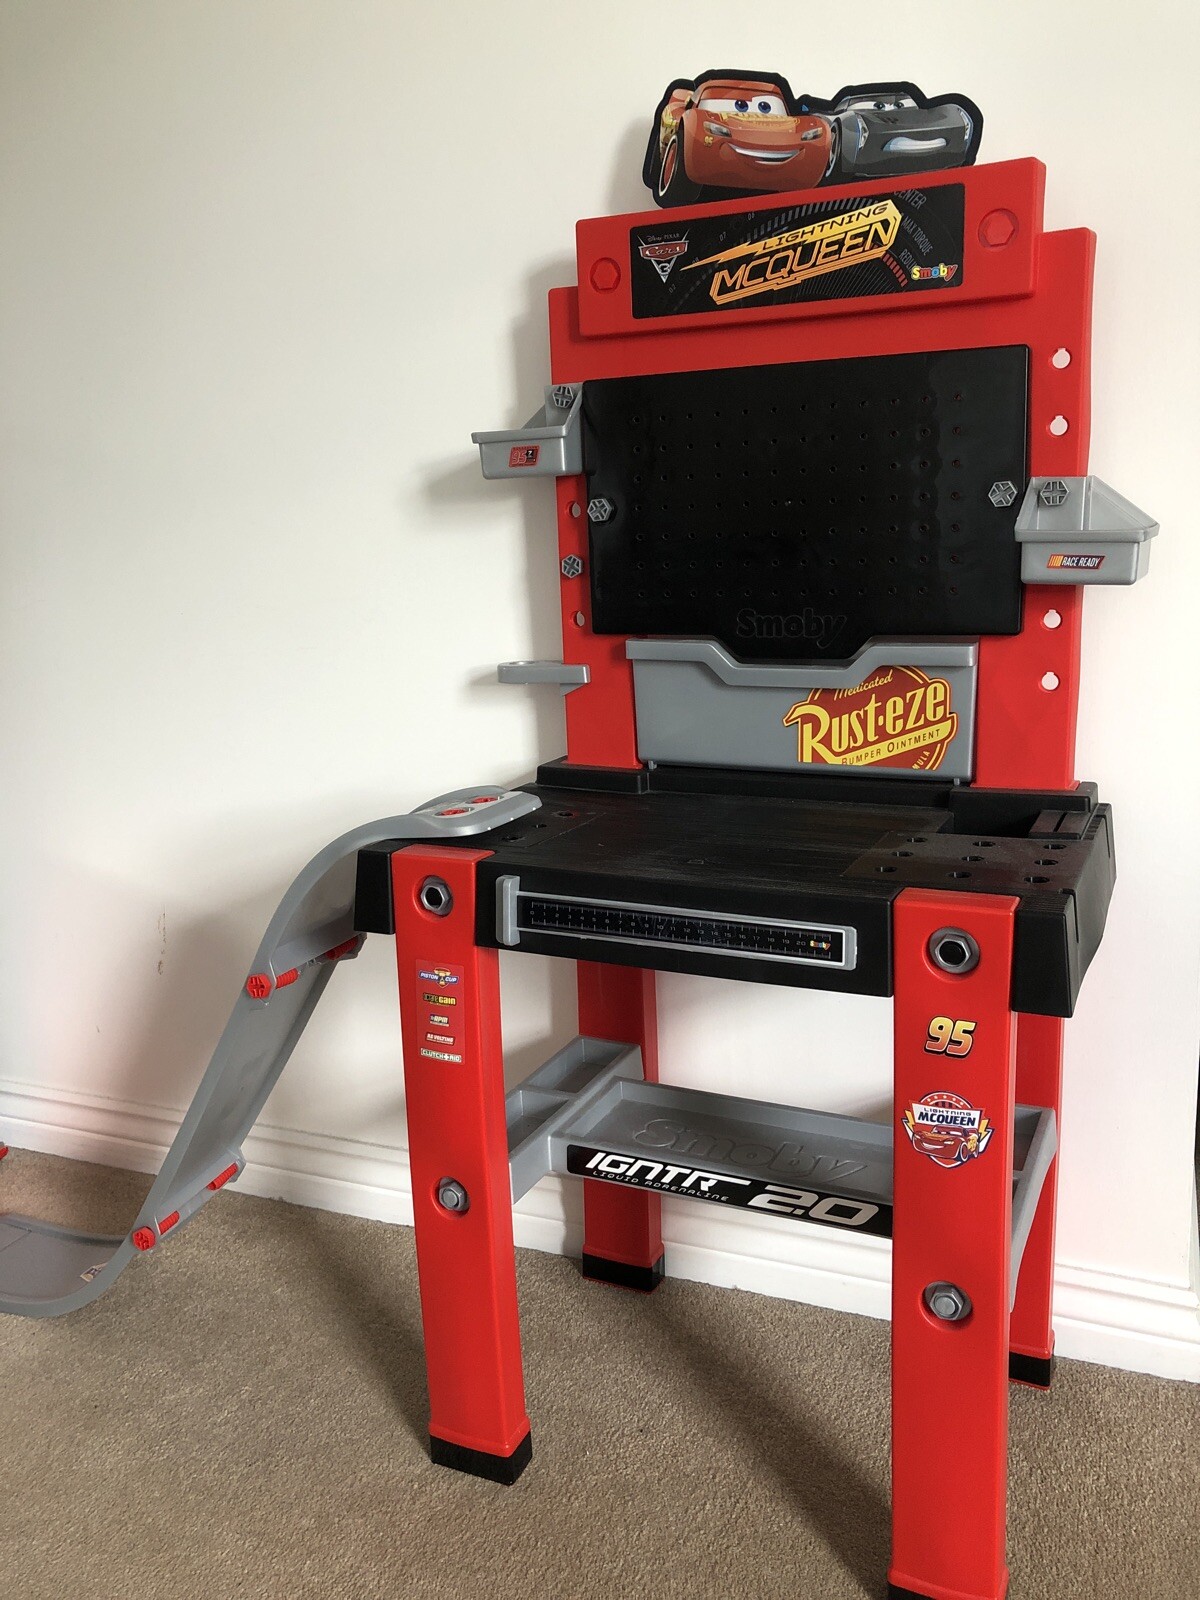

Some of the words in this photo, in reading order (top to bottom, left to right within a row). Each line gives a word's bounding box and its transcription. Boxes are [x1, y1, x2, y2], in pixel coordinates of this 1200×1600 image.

[762, 202, 889, 251] LIGHTNING
[901, 215, 917, 236] MAX
[912, 228, 934, 256] TORQUE
[645, 246, 682, 257] Cars
[711, 216, 898, 299] MCQUEEN
[658, 263, 671, 275] 3
[1061, 556, 1079, 567] RACE
[1078, 557, 1101, 567] READY
[736, 607, 847, 648] Smoby
[887, 728, 941, 753] OINTMENT
[420, 972, 439, 980] PISTON
[924, 1015, 978, 1058] 95
[917, 1113, 977, 1127] MCQUEEN
[923, 1107, 972, 1117] LIGHTNING
[592, 1170, 639, 1184] LIQUID
[644, 1180, 730, 1202] ADRENALINE
[747, 1184, 880, 1226] 2.0
